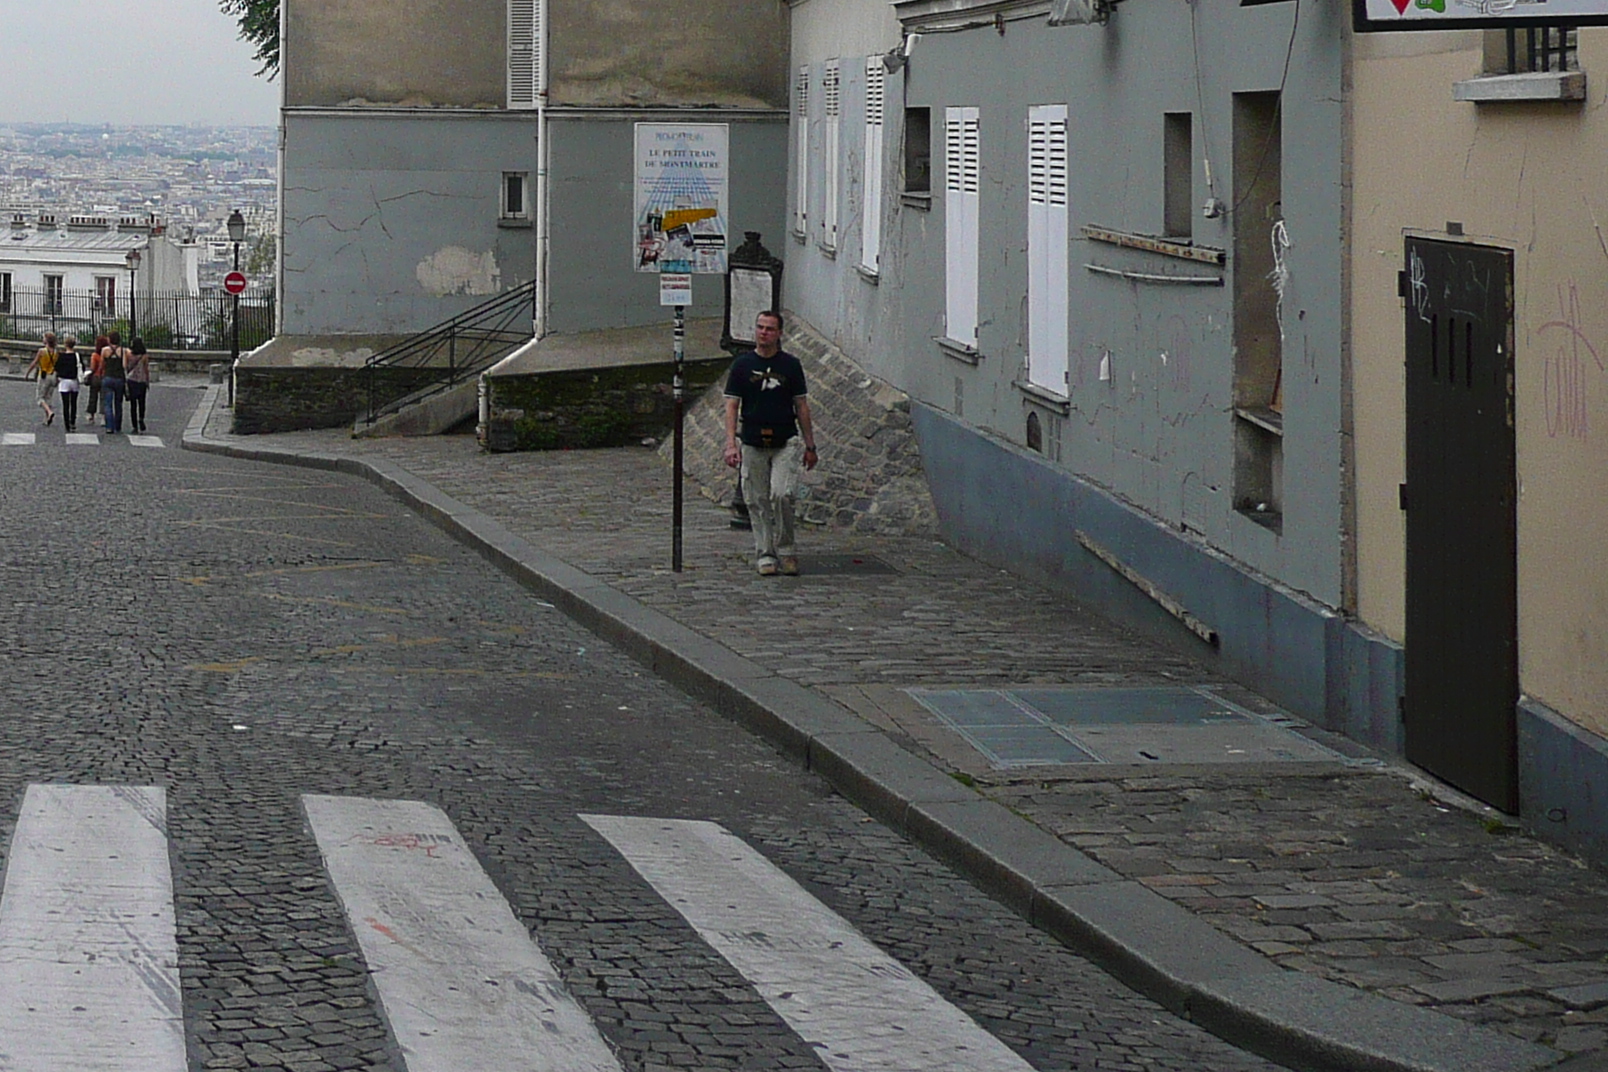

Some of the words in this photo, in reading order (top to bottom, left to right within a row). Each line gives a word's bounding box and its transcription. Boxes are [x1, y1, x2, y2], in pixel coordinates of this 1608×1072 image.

[649, 149, 658, 157] LE
[663, 149, 686, 158] PETIT
[689, 150, 716, 158] TRAIN
[644, 160, 654, 168] DE
[659, 160, 719, 169] MONTMARTRE
